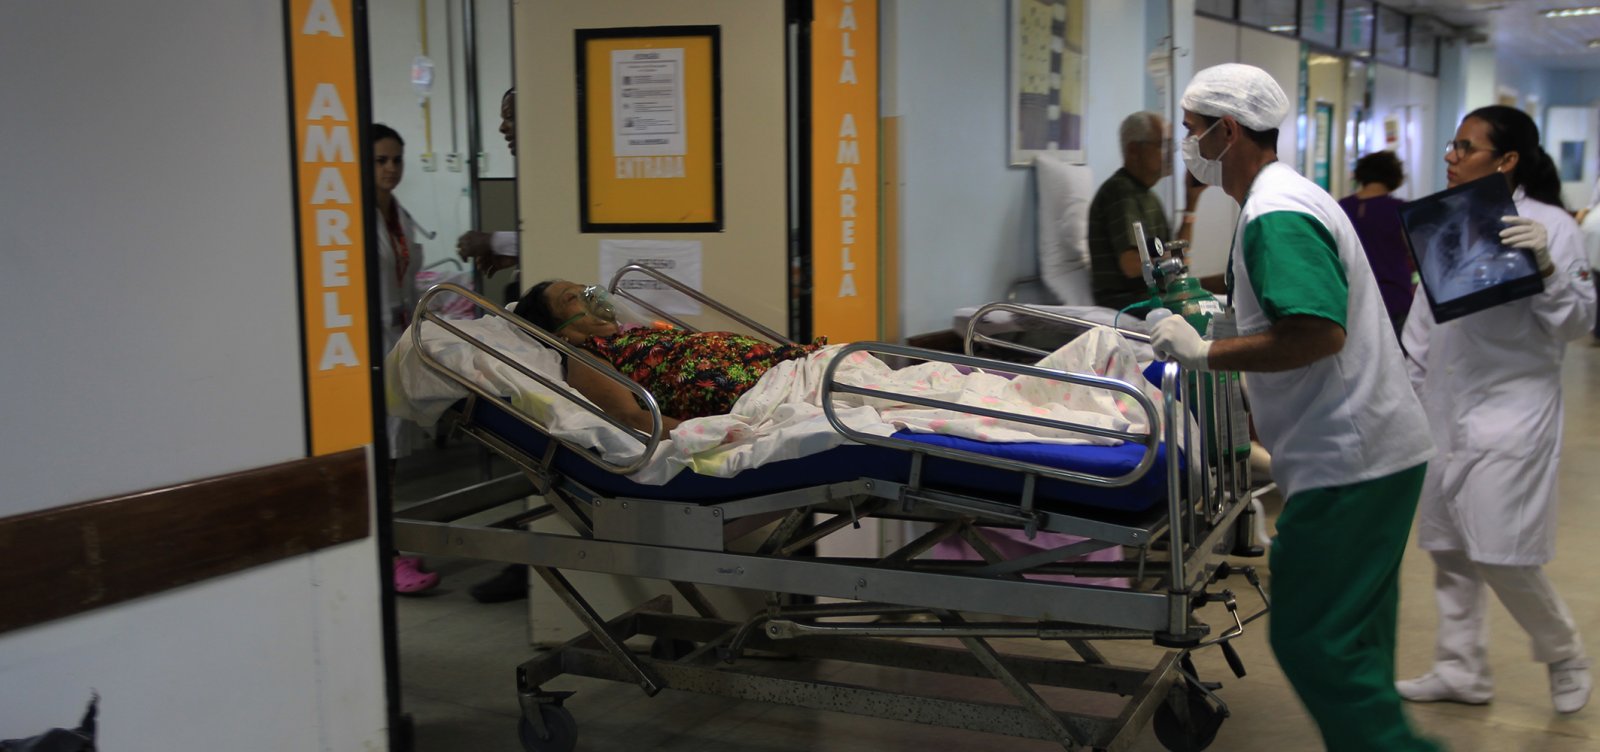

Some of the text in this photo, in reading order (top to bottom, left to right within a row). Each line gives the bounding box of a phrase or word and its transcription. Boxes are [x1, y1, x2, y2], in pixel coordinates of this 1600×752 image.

[303, 83, 360, 370] AMARELA
[615, 157, 686, 178] ENTRADA
[836, 0, 861, 298] ALA AMARELA
